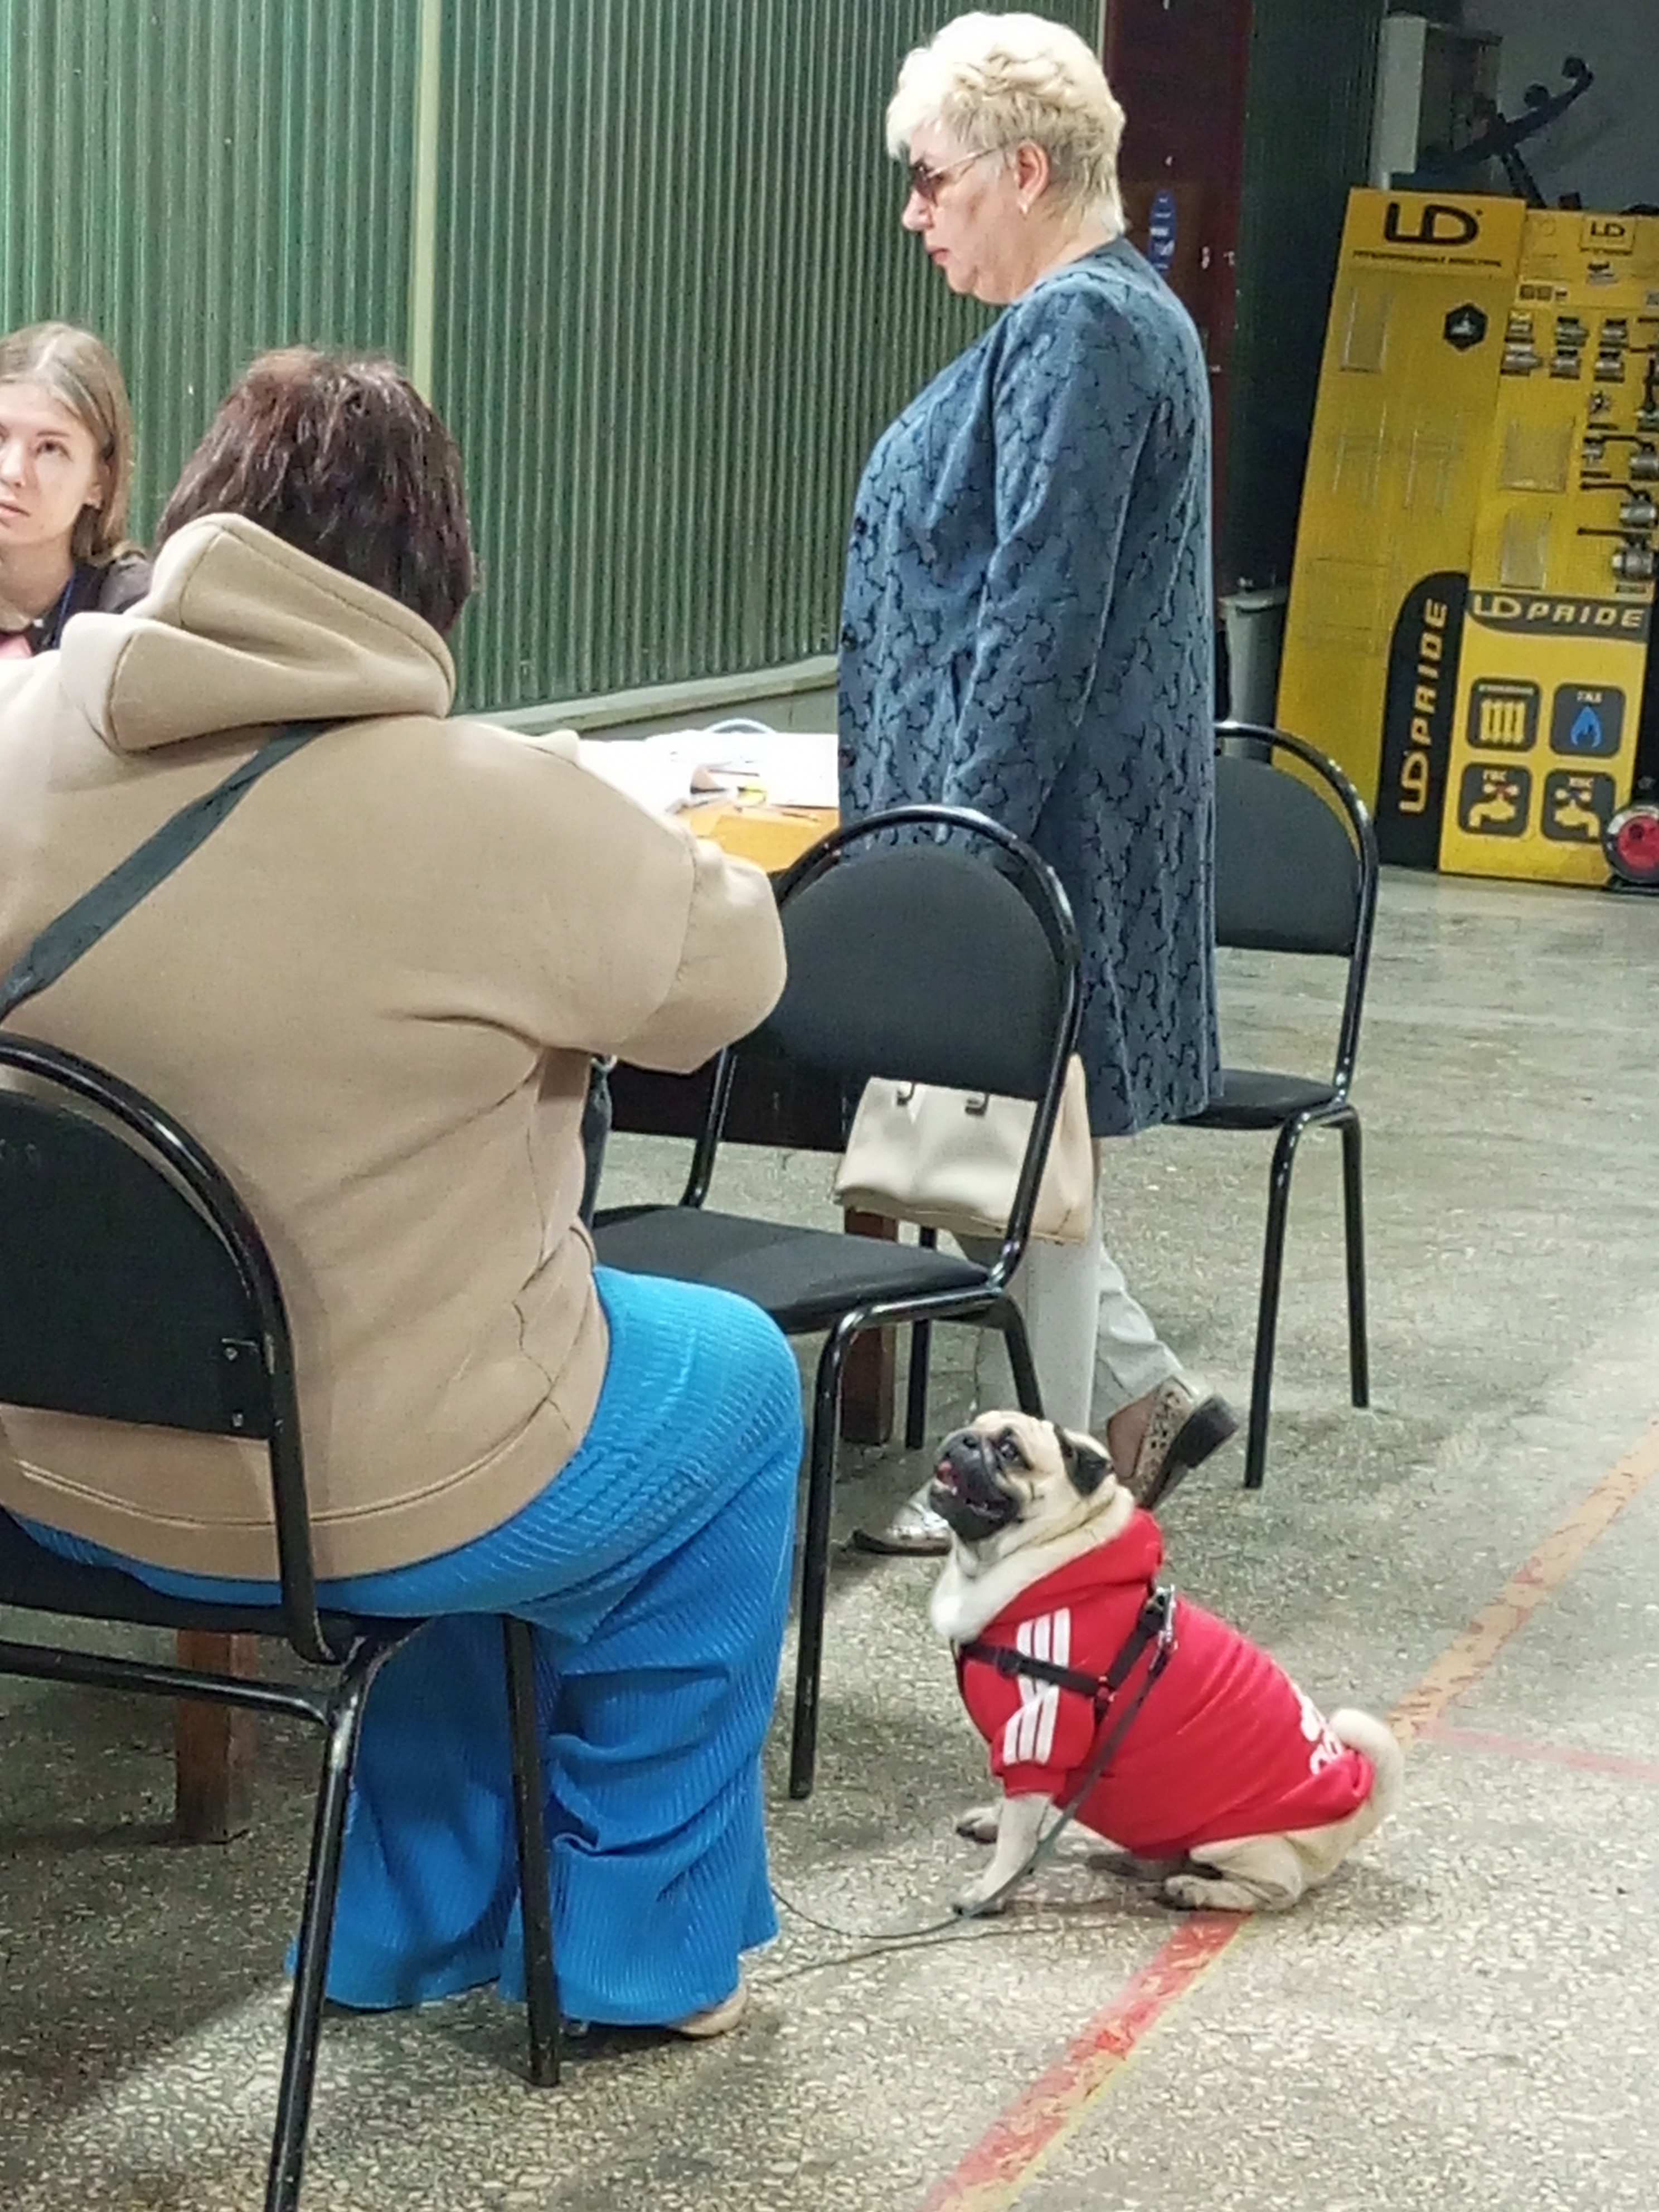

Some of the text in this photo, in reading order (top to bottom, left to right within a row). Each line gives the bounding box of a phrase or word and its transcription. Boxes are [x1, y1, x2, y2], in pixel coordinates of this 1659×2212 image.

[1384, 202, 1479, 246] LD
[1526, 602, 1645, 628] PRIDE
[1410, 598, 1448, 746] PRIDE
